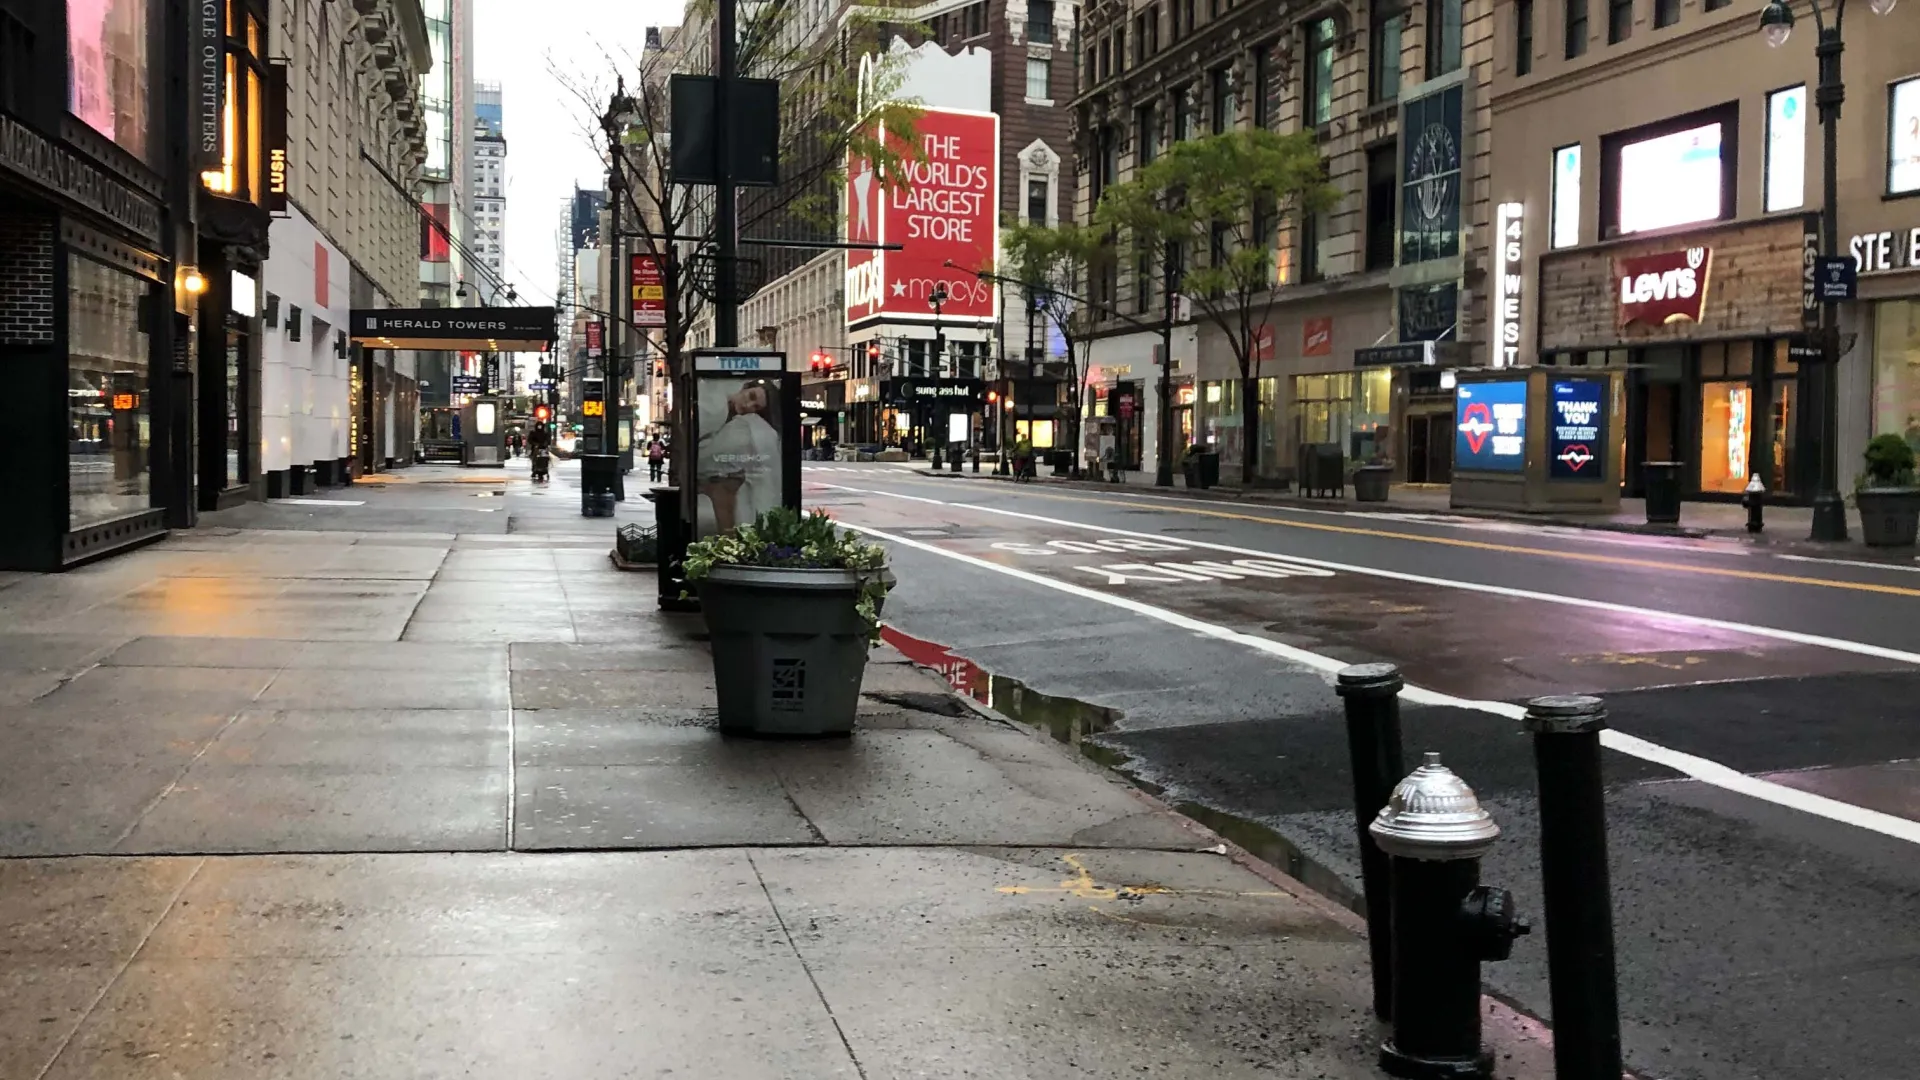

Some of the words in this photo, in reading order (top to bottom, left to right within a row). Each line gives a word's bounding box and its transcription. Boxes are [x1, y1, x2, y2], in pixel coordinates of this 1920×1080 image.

[202, 46, 217, 152] OUTFITTERS
[924, 134, 961, 160] THE
[270, 149, 285, 193] LUSH
[893, 159, 988, 190] WORLD'S
[893, 185, 985, 216] LARGEST
[907, 214, 973, 243] STORE
[1850, 227, 1920, 273] STEVE
[383, 319, 442, 329] HERALD
[448, 320, 507, 330] TOWERS
[1503, 274, 1521, 367] WEST
[719, 357, 760, 369] TITAN
[954, 384, 969, 397] hut
[1556, 400, 1598, 414] THANK
[1564, 412, 1590, 425] YOU
[712, 453, 771, 463] VERISHOP
